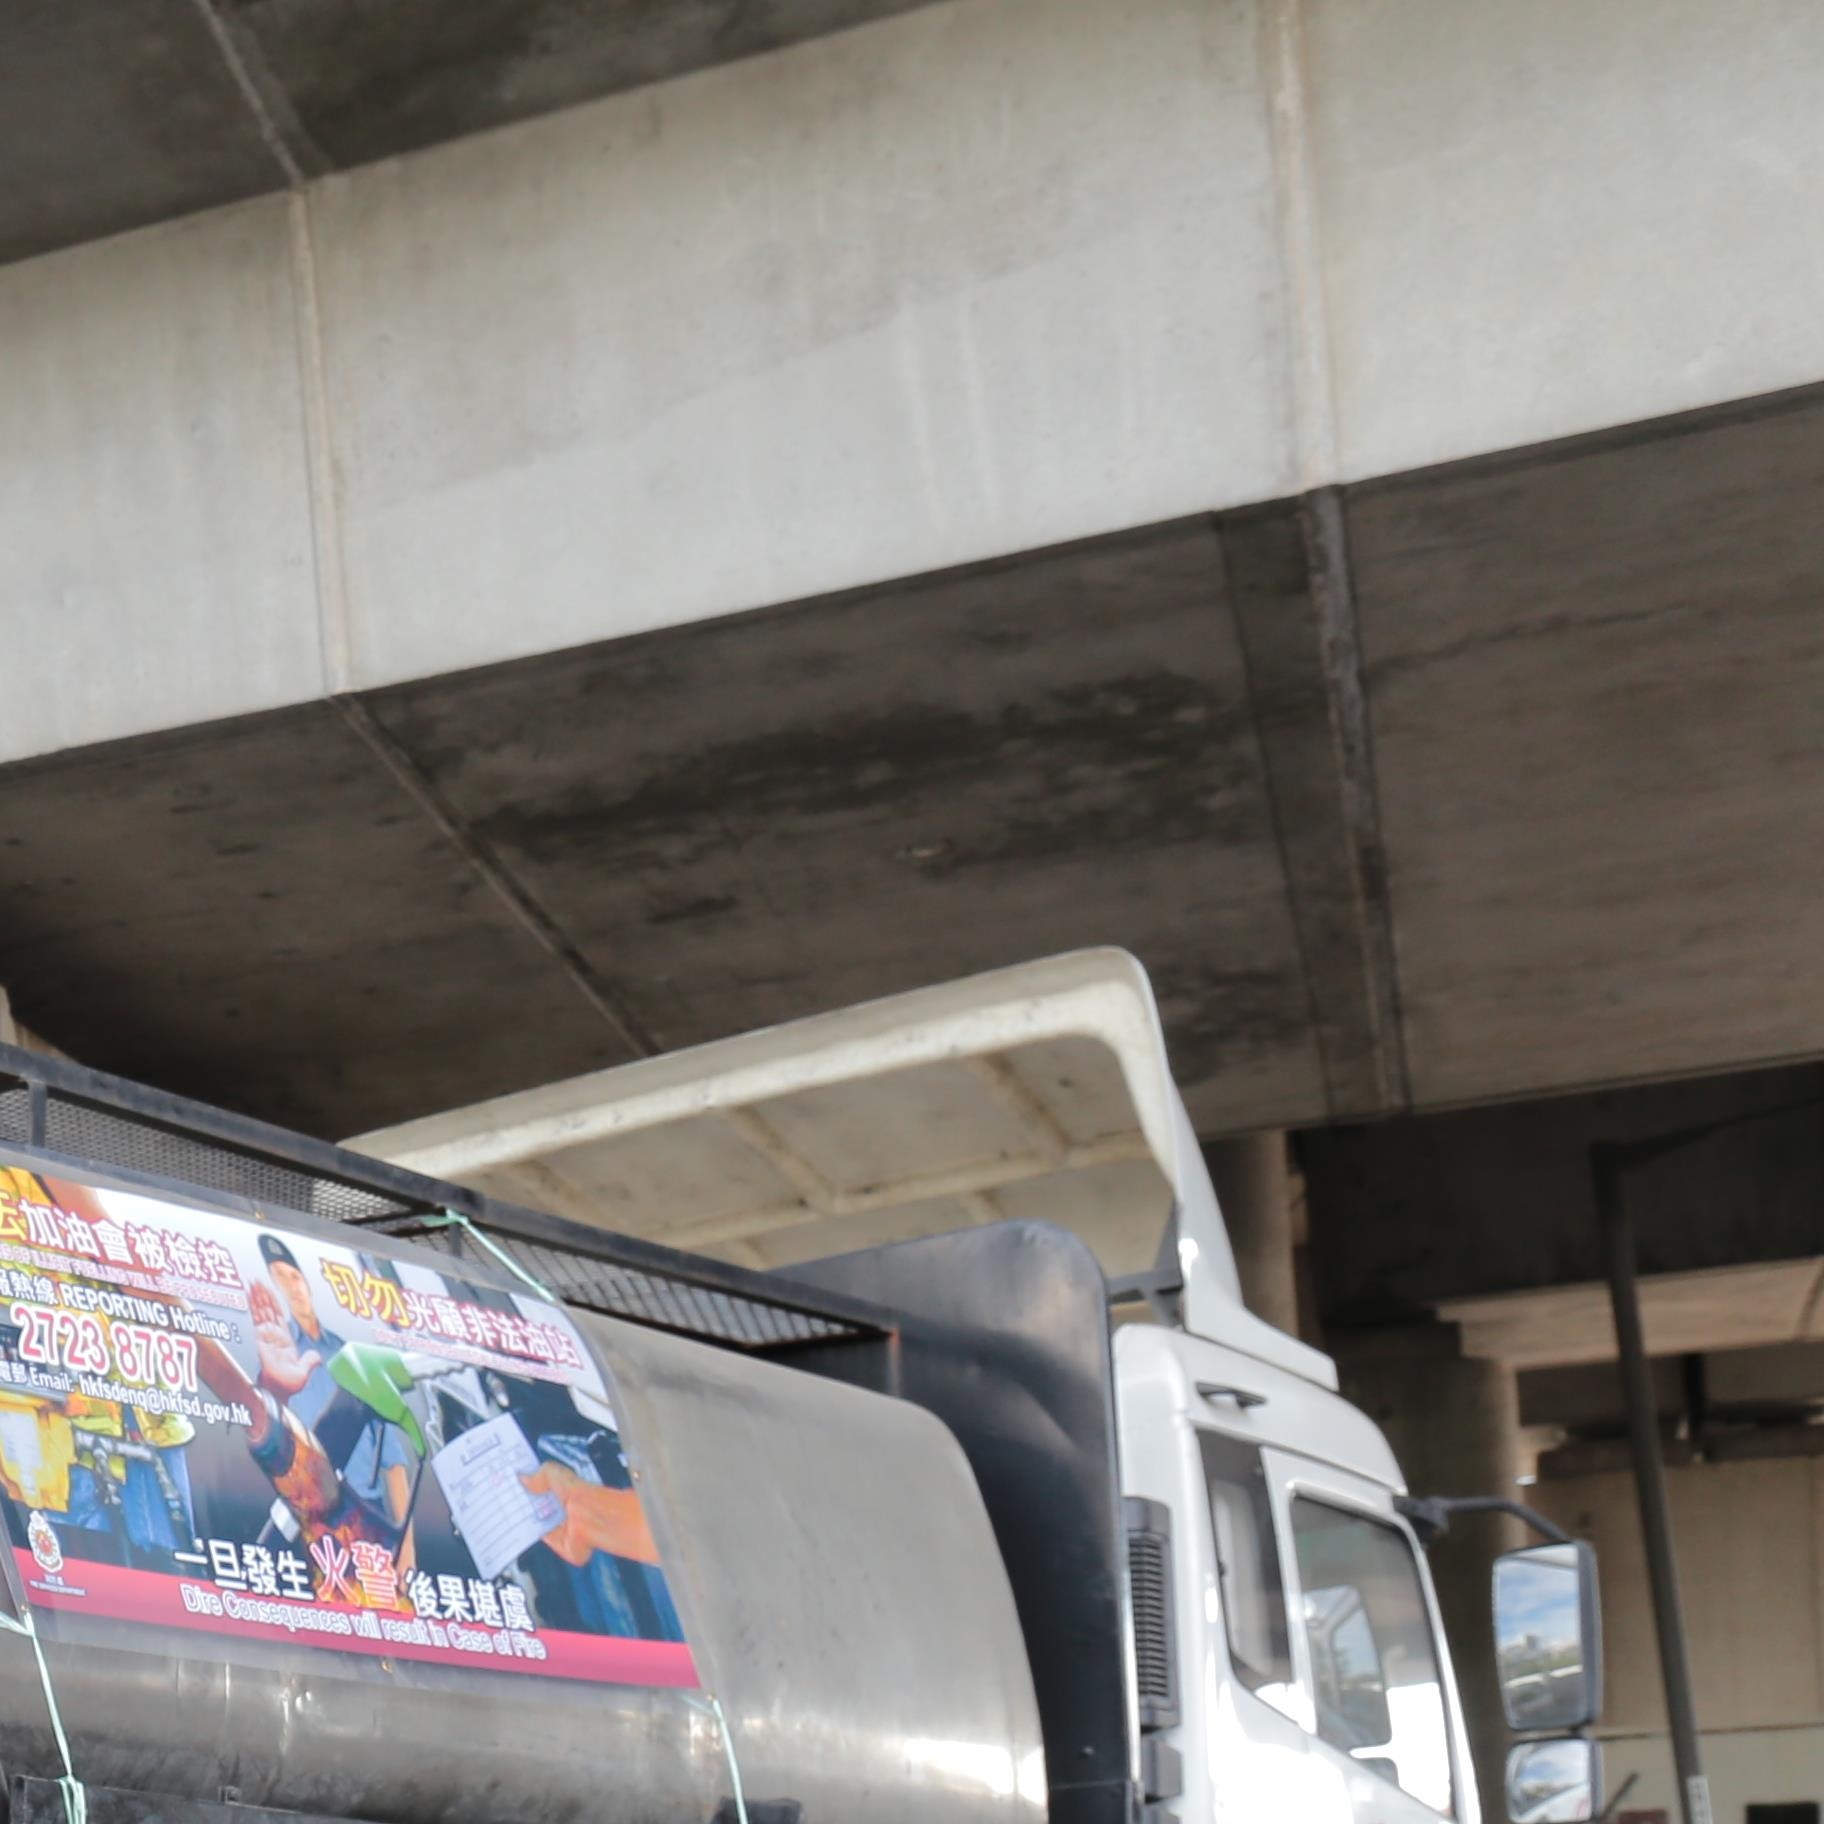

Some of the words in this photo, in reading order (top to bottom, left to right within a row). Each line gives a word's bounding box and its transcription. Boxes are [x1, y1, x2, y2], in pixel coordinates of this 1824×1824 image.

[59, 1283, 167, 1326] REPORTING
[320, 1257, 583, 1369] 切勿光顧非法油站
[11, 1303, 110, 1376] 2723
[111, 1321, 197, 1393] 8787
[29, 1364, 74, 1393] Email:
[80, 1374, 252, 1426] hkfsdenq@hkfsd.gov.hk
[175, 1535, 536, 1633] 一旦發生火警後果堪虞
[180, 1583, 223, 1616] Dire
[225, 1590, 350, 1636] Consequences
[350, 1611, 383, 1641] will
[383, 1613, 431, 1646] result
[432, 1621, 450, 1648] in
[449, 1622, 492, 1655] Case
[493, 1630, 513, 1656] of
